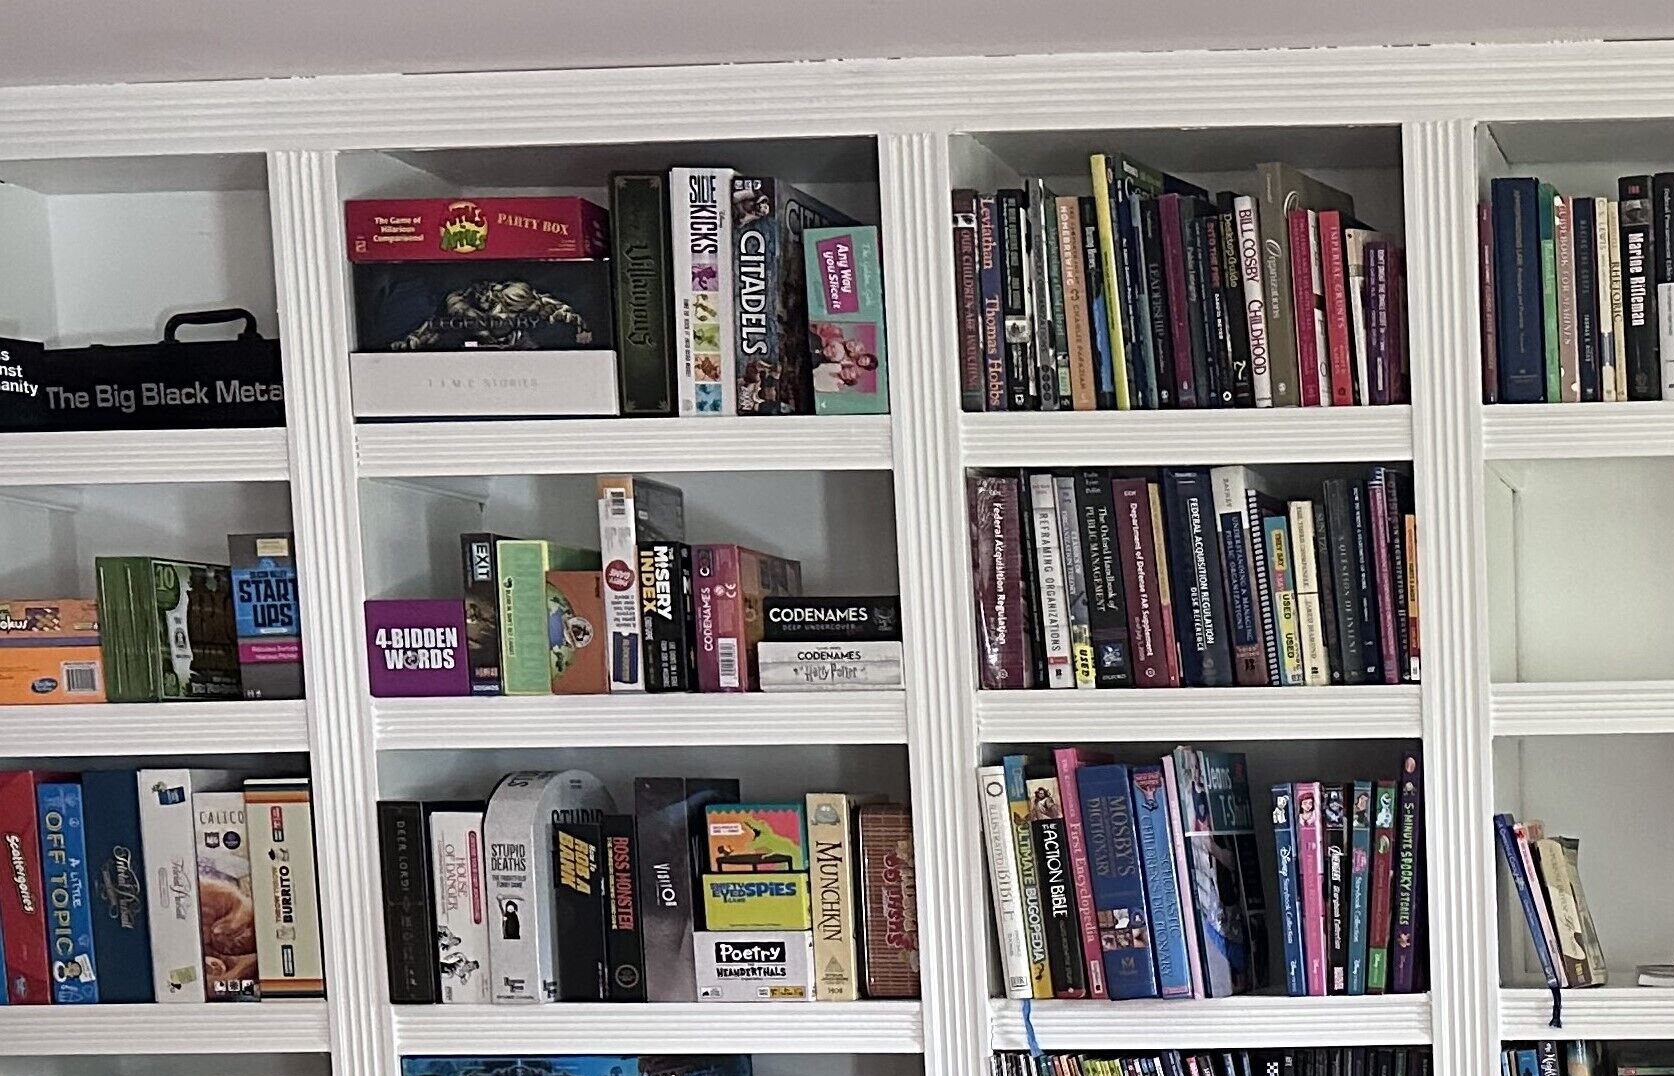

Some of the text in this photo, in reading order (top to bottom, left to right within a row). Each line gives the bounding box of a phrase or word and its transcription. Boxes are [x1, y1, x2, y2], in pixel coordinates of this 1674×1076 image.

[498, 213, 569, 236] PARTY BOX
[1060, 205, 1073, 286] HOMEBREWING
[1239, 209, 1259, 283] BILL COSBY
[740, 231, 767, 357] CITADELS
[1610, 261, 1623, 323] RHETORIC
[1628, 232, 1647, 327] Marine Rifleman
[426, 317, 540, 329] LEGENDARY
[1248, 299, 1267, 376] CHILDHOOD
[46, 380, 283, 413] The Big Black Meta
[1129, 503, 1141, 550] Department
[476, 543, 489, 579] EXIT
[640, 551, 657, 613] INDEX
[654, 546, 672, 620] MISERY
[993, 503, 1007, 645] Federal Acquisition Regulation
[1039, 513, 1062, 652] REFRAMING ORGANIZATIONS
[1137, 562, 1147, 592] Defense
[1190, 498, 1215, 645] FEDERAL ACQUISITION REGULATION
[253, 603, 292, 627] UPS
[703, 587, 713, 651] CODENAMES
[769, 607, 868, 622] CODENAMES
[1140, 594, 1149, 610] FAR
[1282, 594, 1292, 620] USED
[376, 628, 458, 648] 4-BIDDEN
[798, 651, 861, 661] CODENAMES
[1142, 612, 1154, 657] Supplement
[1287, 632, 1295, 659] USED
[1079, 648, 1090, 677] USED
[200, 811, 244, 825] CALICO
[491, 844, 526, 857] STUPID
[491, 858, 526, 872] DEATHS
[559, 831, 576, 889] BANK
[1043, 830, 1067, 919] ACTION BIBLE
[45, 811, 73, 956] OFF TOPIC
[281, 865, 293, 923] BURRITO
[613, 836, 633, 930] BOSS MONSTER
[816, 841, 843, 942] MUNCHKIN
[1017, 826, 1045, 963] ULTIMATE BUGOPEDIA
[720, 943, 780, 962] Poetry
